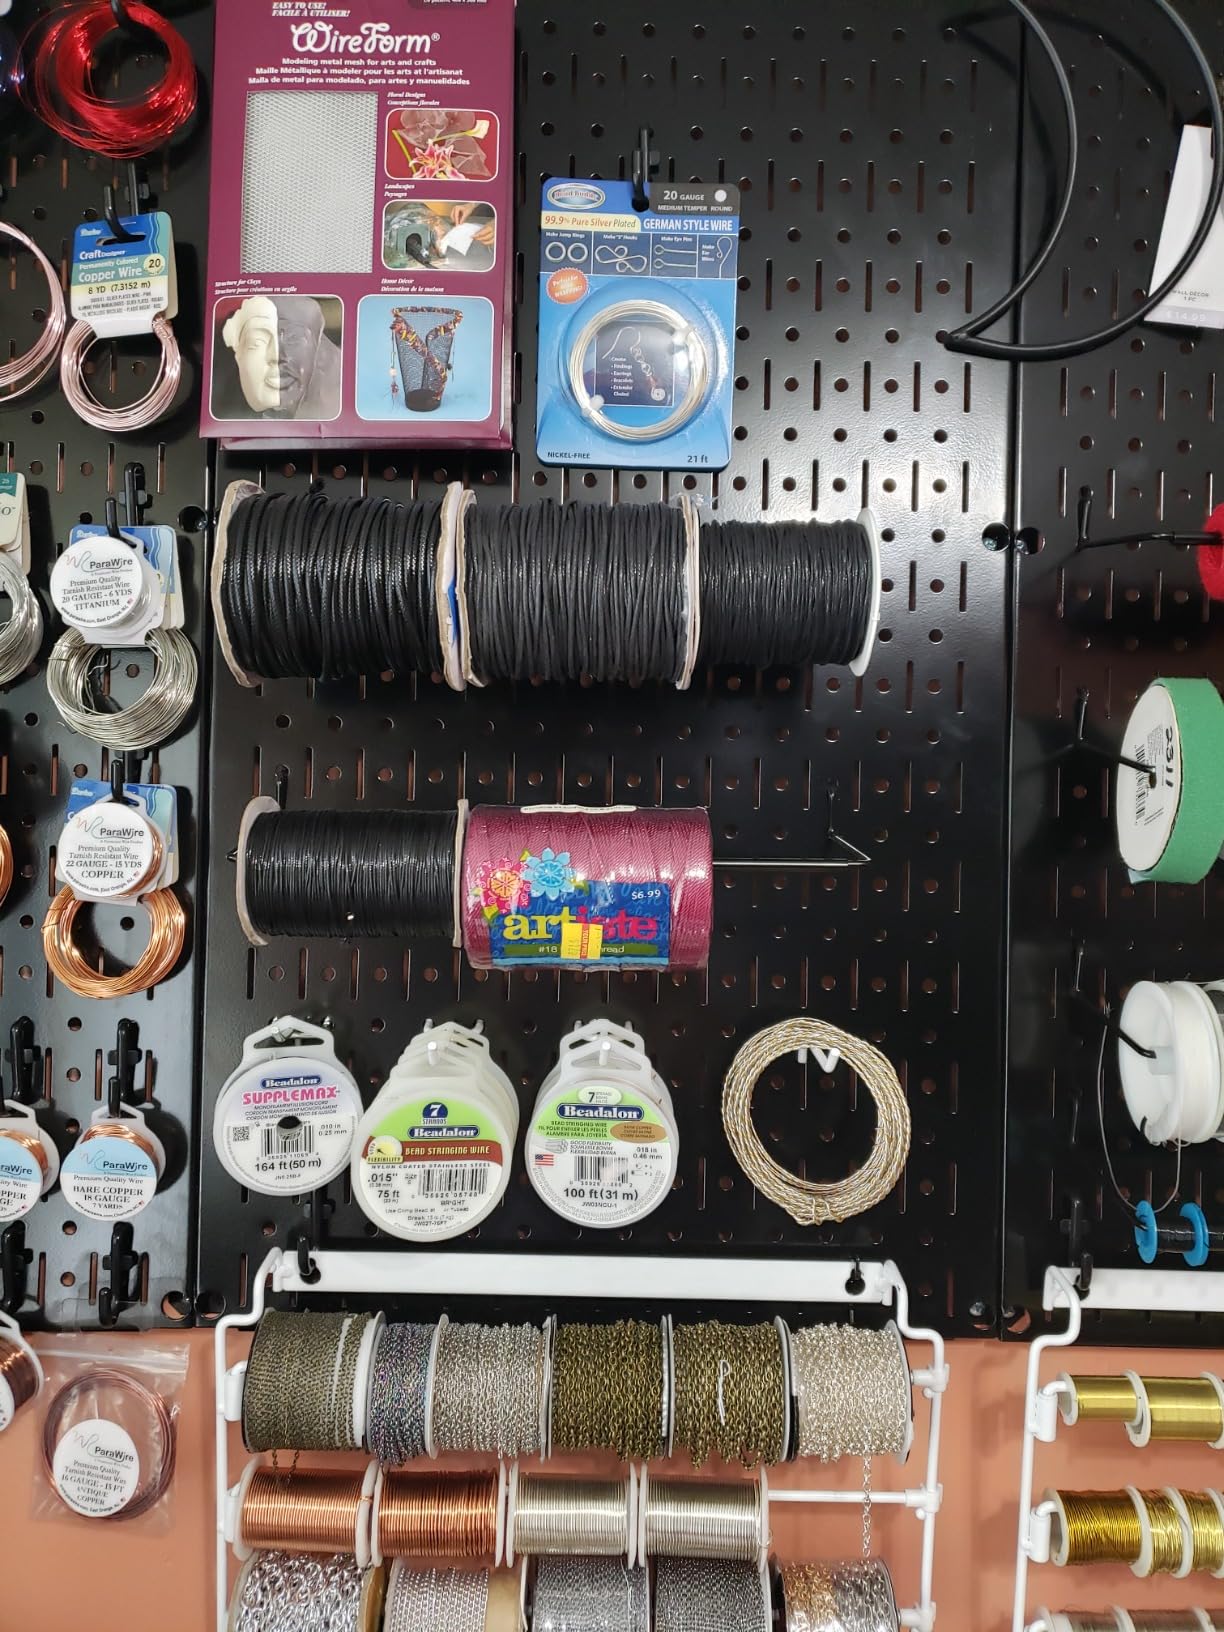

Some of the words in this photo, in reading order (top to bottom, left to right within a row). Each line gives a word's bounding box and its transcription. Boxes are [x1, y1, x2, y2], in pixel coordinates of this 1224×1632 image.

[272, 2, 292, 10] EASY
[294, 2, 306, 10] TO
[307, 2, 326, 10] USE!
[310, 10, 350, 18] UTILISER!
[282, 58, 318, 66] Modeling
[424, 68, 463, 76] l'artisanat
[326, 76, 366, 84] modelado,
[663, 190, 678, 200] 20
[572, 218, 589, 226] Pure
[590, 218, 612, 228] Silver
[613, 218, 636, 228] Plated
[644, 218, 682, 230] GERMAN
[683, 219, 710, 231] STYLE
[711, 220, 733, 231] WIRE
[116, 258, 138, 266] Colored
[149, 258, 161, 268] 20
[78, 270, 116, 282] Copper
[118, 267, 142, 278] Wire
[140, 280, 151, 288] m)
[547, 452, 590, 460] NICKEL-FREE
[688, 455, 698, 463] 21
[700, 455, 708, 464] ft
[90, 558, 133, 570] ParaWire
[70, 578, 98, 588] Premium
[98, 575, 121, 584] Quality
[63, 586, 85, 595] Tarnish
[86, 582, 114, 592] Resistant
[115, 580, 130, 590] Wire
[62, 594, 71, 604] 20
[72, 592, 102, 602] GAUGE
[108, 590, 114, 598] 6
[115, 588, 133, 596] YDS
[74, 598, 120, 611] TITANIUM
[100, 828, 144, 839] ParaWire
[78, 844, 106, 852] Premium
[108, 845, 130, 853] Quality
[70, 852, 92, 860] Tarnish
[75, 860, 108, 868] GAUGE
[81, 870, 124, 879] COPPER
[632, 888, 661, 900] $6.99
[265, 1077, 318, 1088] Beadalon
[243, 1086, 337, 1105] SUPPLEMAX
[588, 1092, 595, 1103] 7
[430, 1104, 441, 1116] 7
[564, 1105, 640, 1119] Beadalon
[413, 1128, 477, 1137] Beadalon
[405, 1147, 425, 1155] BEAD
[428, 1147, 468, 1155] STRINGING
[470, 1146, 490, 1154] WIRE
[103, 1161, 148, 1172] ParaWire
[255, 1162, 275, 1172] 164
[278, 1161, 287, 1170] ft
[289, 1160, 306, 1170] (50
[308, 1158, 322, 1168] m)
[104, 1176, 126, 1184] Quality
[73, 1186, 100, 1194] BARE
[103, 1187, 143, 1196] COPPER
[378, 1190, 390, 1198] 75
[392, 1189, 400, 1198] ft
[564, 1188, 585, 1198] 100
[589, 1188, 598, 1199] ft
[600, 1188, 618, 1200] (31
[622, 1190, 638, 1201] m)
[95, 1195, 131, 1203] GAUGE
[95, 1446, 134, 1462] ParaWire
[64, 1466, 86, 1475] Tarnish
[73, 1460, 99, 1471] Premium
[100, 1466, 120, 1476] Quality
[70, 1476, 99, 1488] GAUGE
[78, 1487, 109, 1498] ANTIQUE
[77, 1495, 105, 1505] COPPER
